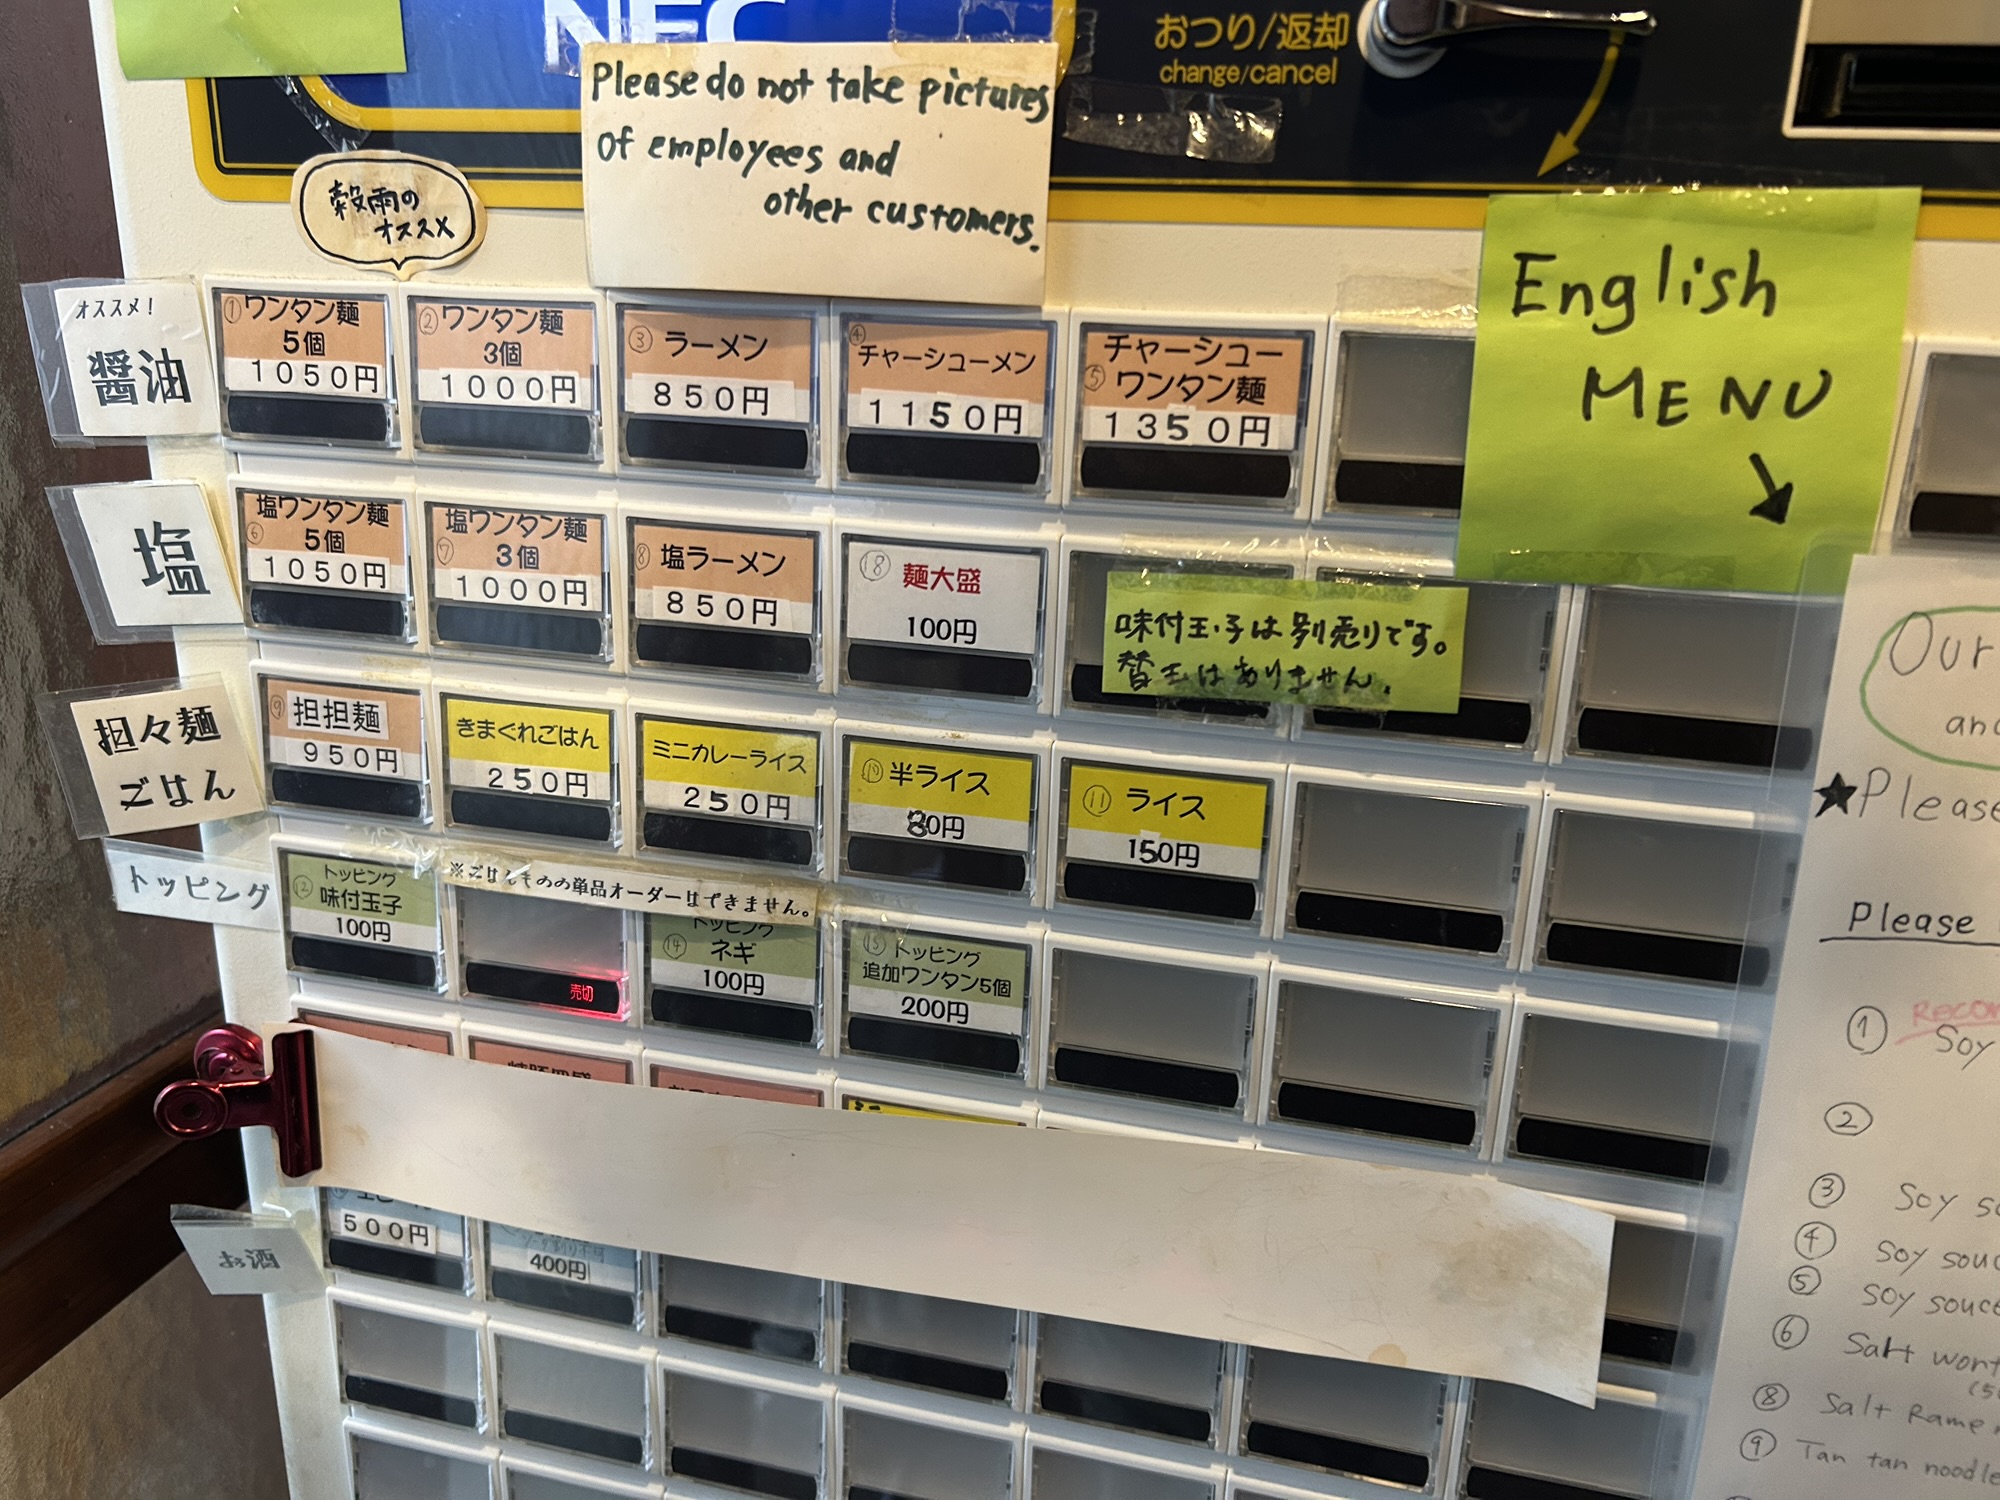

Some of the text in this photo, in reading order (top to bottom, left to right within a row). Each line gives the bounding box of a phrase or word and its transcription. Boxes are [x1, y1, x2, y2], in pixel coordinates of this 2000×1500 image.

[1155, 12, 1350, 50] おつり/返却
[1159, 57, 1338, 88] change/cancel
[592, 60, 1050, 123] Please do not take pictures
[648, 127, 823, 178] employees
[839, 140, 901, 177] and
[328, 179, 420, 221] 穀雨の
[374, 216, 456, 245] オススメ
[764, 183, 1040, 252] other customers.
[1511, 243, 1777, 336] English
[245, 295, 361, 328] ワンタン麺
[441, 305, 564, 336] ワンタン麺
[283, 330, 326, 357] 5個
[483, 341, 523, 368] 3個
[665, 330, 768, 362] ラーメン
[857, 344, 1037, 375] チャーシューメン
[1103, 333, 1284, 369] チャーシュー
[87, 347, 193, 407] 醤油
[251, 360, 379, 394] 1050円
[441, 373, 577, 405] 1000円
[1116, 370, 1267, 406] ワンタン麺
[654, 381, 769, 417] 850円
[1581, 365, 1833, 427] MENU
[869, 399, 1024, 436] 1150円
[1105, 411, 1271, 448] 1350円
[256, 494, 390, 529] 塩ワンタン麺
[445, 507, 588, 544] 塩ワンタン麺
[132, 519, 212, 596] 塩
[304, 527, 346, 555] 5個
[496, 543, 540, 572] 3個
[263, 556, 387, 590] 1050円
[660, 543, 788, 578] 塩ラーメン
[456, 574, 588, 608] 1000円
[902, 562, 983, 596] 麺大盛
[666, 590, 778, 627] 850円
[907, 614, 977, 645] 100円
[1889, 611, 1993, 677] Our
[93, 704, 222, 757] 担々麺
[293, 695, 382, 734] 担担麺
[455, 716, 600, 750] きまぐれごはん
[303, 741, 399, 774] 950円
[651, 738, 808, 775] ミニカレーライス
[119, 768, 236, 812] ごはん
[487, 766, 589, 798] 250円
[889, 761, 991, 797] 半ライス
[683, 786, 792, 821] 250円
[1126, 787, 1206, 821] ライス
[1128, 837, 1201, 869] 150円
[129, 864, 270, 911] トッピング
[324, 863, 397, 888] トッピング
[319, 886, 403, 916] 味付玉子
[336, 916, 392, 943] 100円
[1848, 900, 1976, 938] Please
[710, 939, 758, 966] ネギ
[895, 941, 982, 968] トッピング
[569, 983, 594, 1003] 売切
[702, 969, 765, 996] 100円
[862, 961, 1012, 998] 追加ワンタン5個
[900, 995, 970, 1025] 200円
[1935, 1023, 1996, 1071] Soy
[343, 1213, 429, 1247] 500円
[529, 1253, 587, 1281] 400円
[1819, 1392, 1892, 1420] Salt
[1796, 1438, 1847, 1464] Tan
[1867, 1451, 1909, 1471] tan
